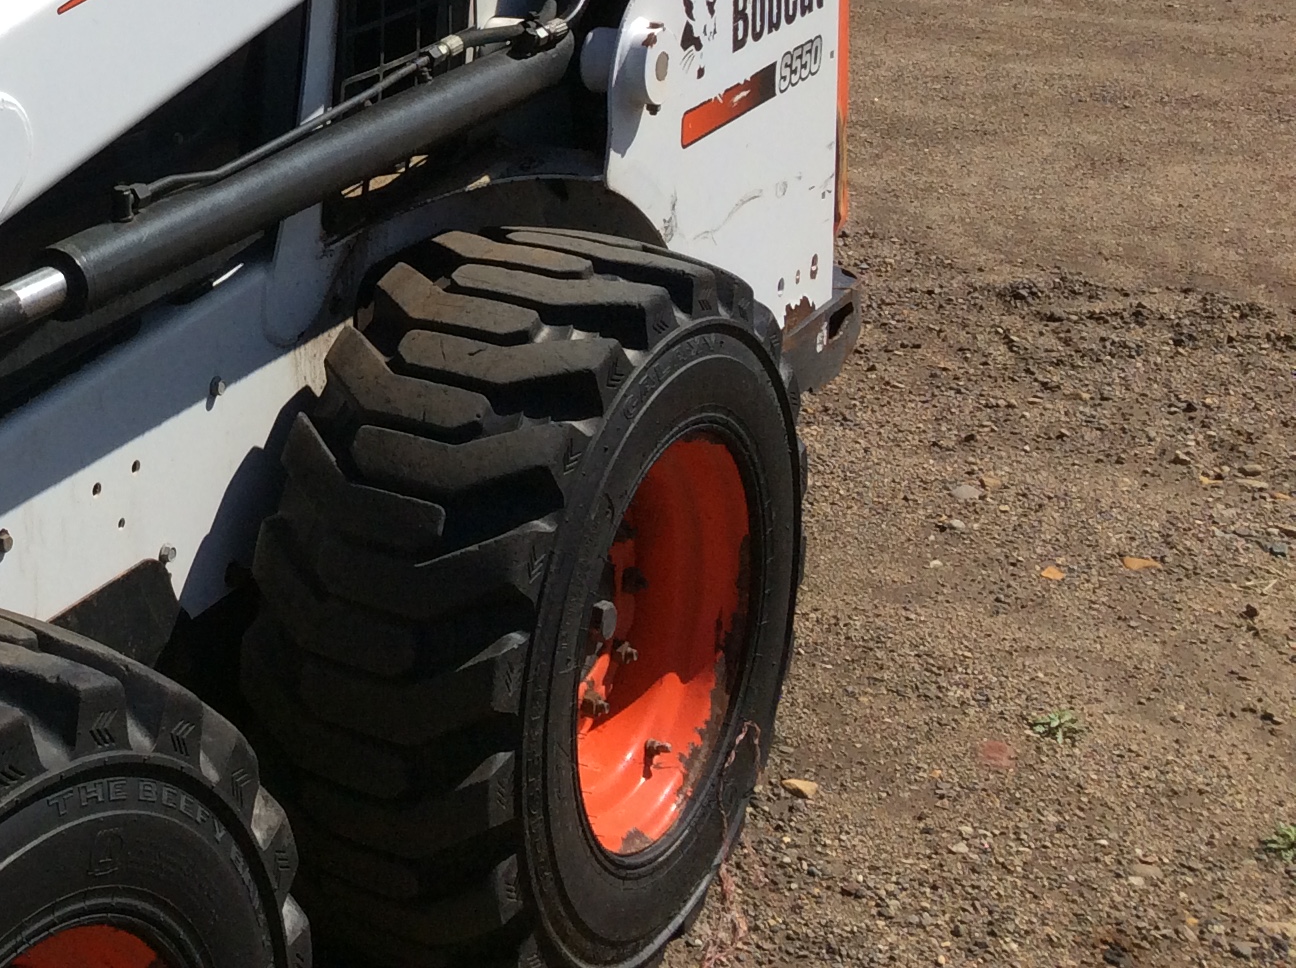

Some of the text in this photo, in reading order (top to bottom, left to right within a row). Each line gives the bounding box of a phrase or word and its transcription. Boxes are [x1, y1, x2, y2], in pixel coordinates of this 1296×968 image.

[778, 34, 823, 94] S550
[46, 776, 228, 844] THE BEEFY
